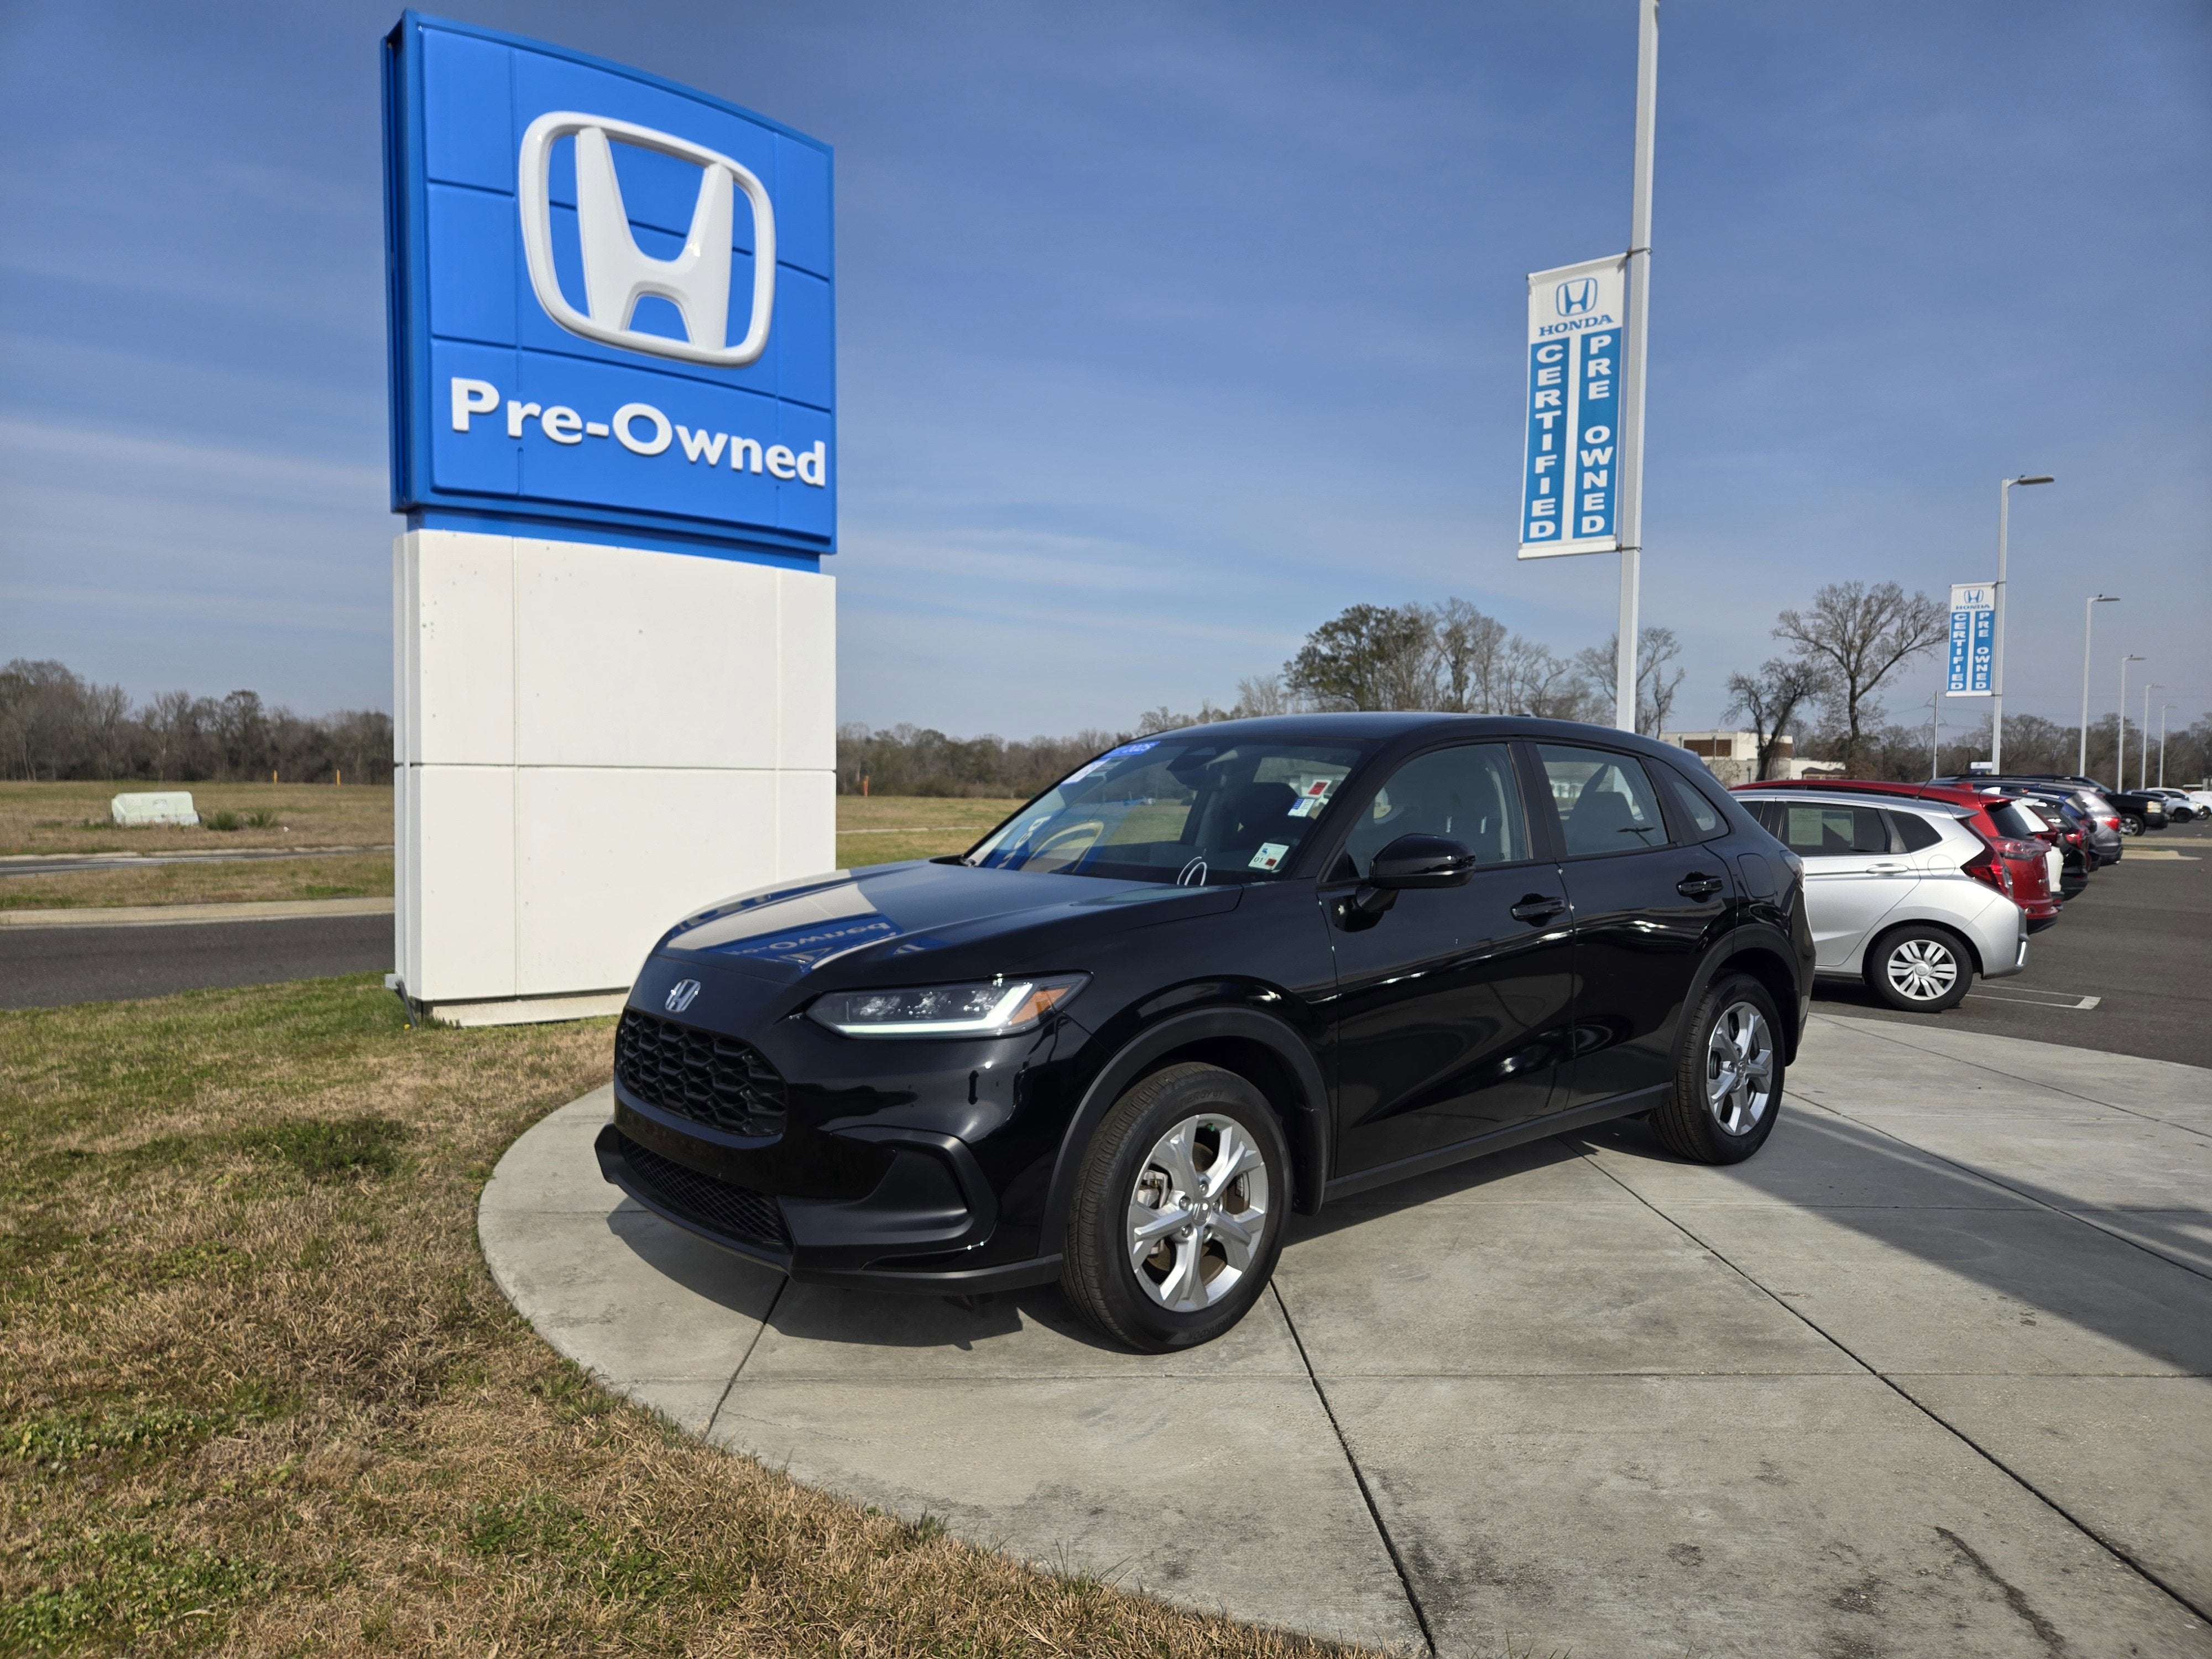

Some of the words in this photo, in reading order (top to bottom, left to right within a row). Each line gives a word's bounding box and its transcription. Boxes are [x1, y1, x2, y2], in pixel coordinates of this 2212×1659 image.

[1538, 314, 1614, 336] HONDA
[1587, 335, 1612, 400] PRE
[451, 377, 826, 487] Pre-Owned
[1529, 344, 1563, 539] CERTIFIED
[1580, 425, 1614, 534] OWNED
[1950, 613, 1967, 690] CERTIFIED
[1978, 612, 1990, 638] PRE
[1975, 646, 1990, 689] OWNED
